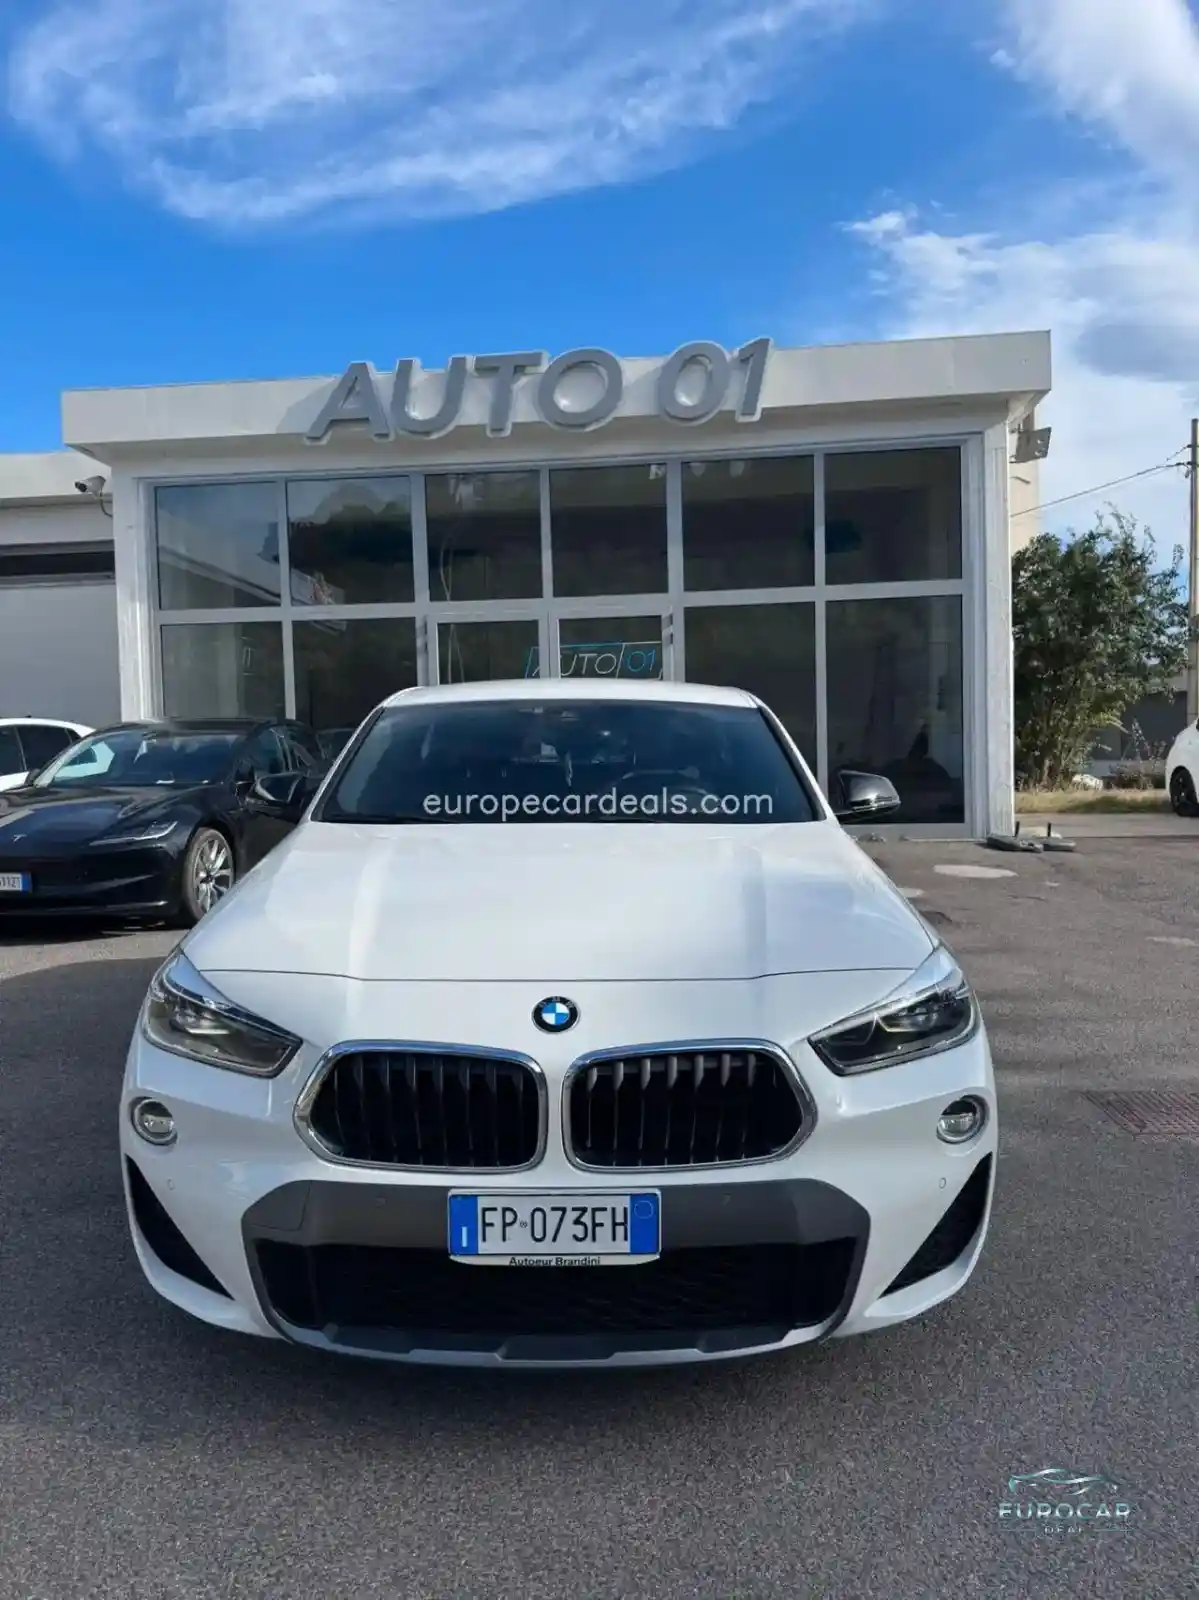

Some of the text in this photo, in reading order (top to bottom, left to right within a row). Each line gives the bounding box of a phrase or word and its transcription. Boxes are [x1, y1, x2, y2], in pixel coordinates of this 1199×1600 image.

[303, 337, 773, 445] AUTO 01
[555, 1257, 601, 1267] Brandini
